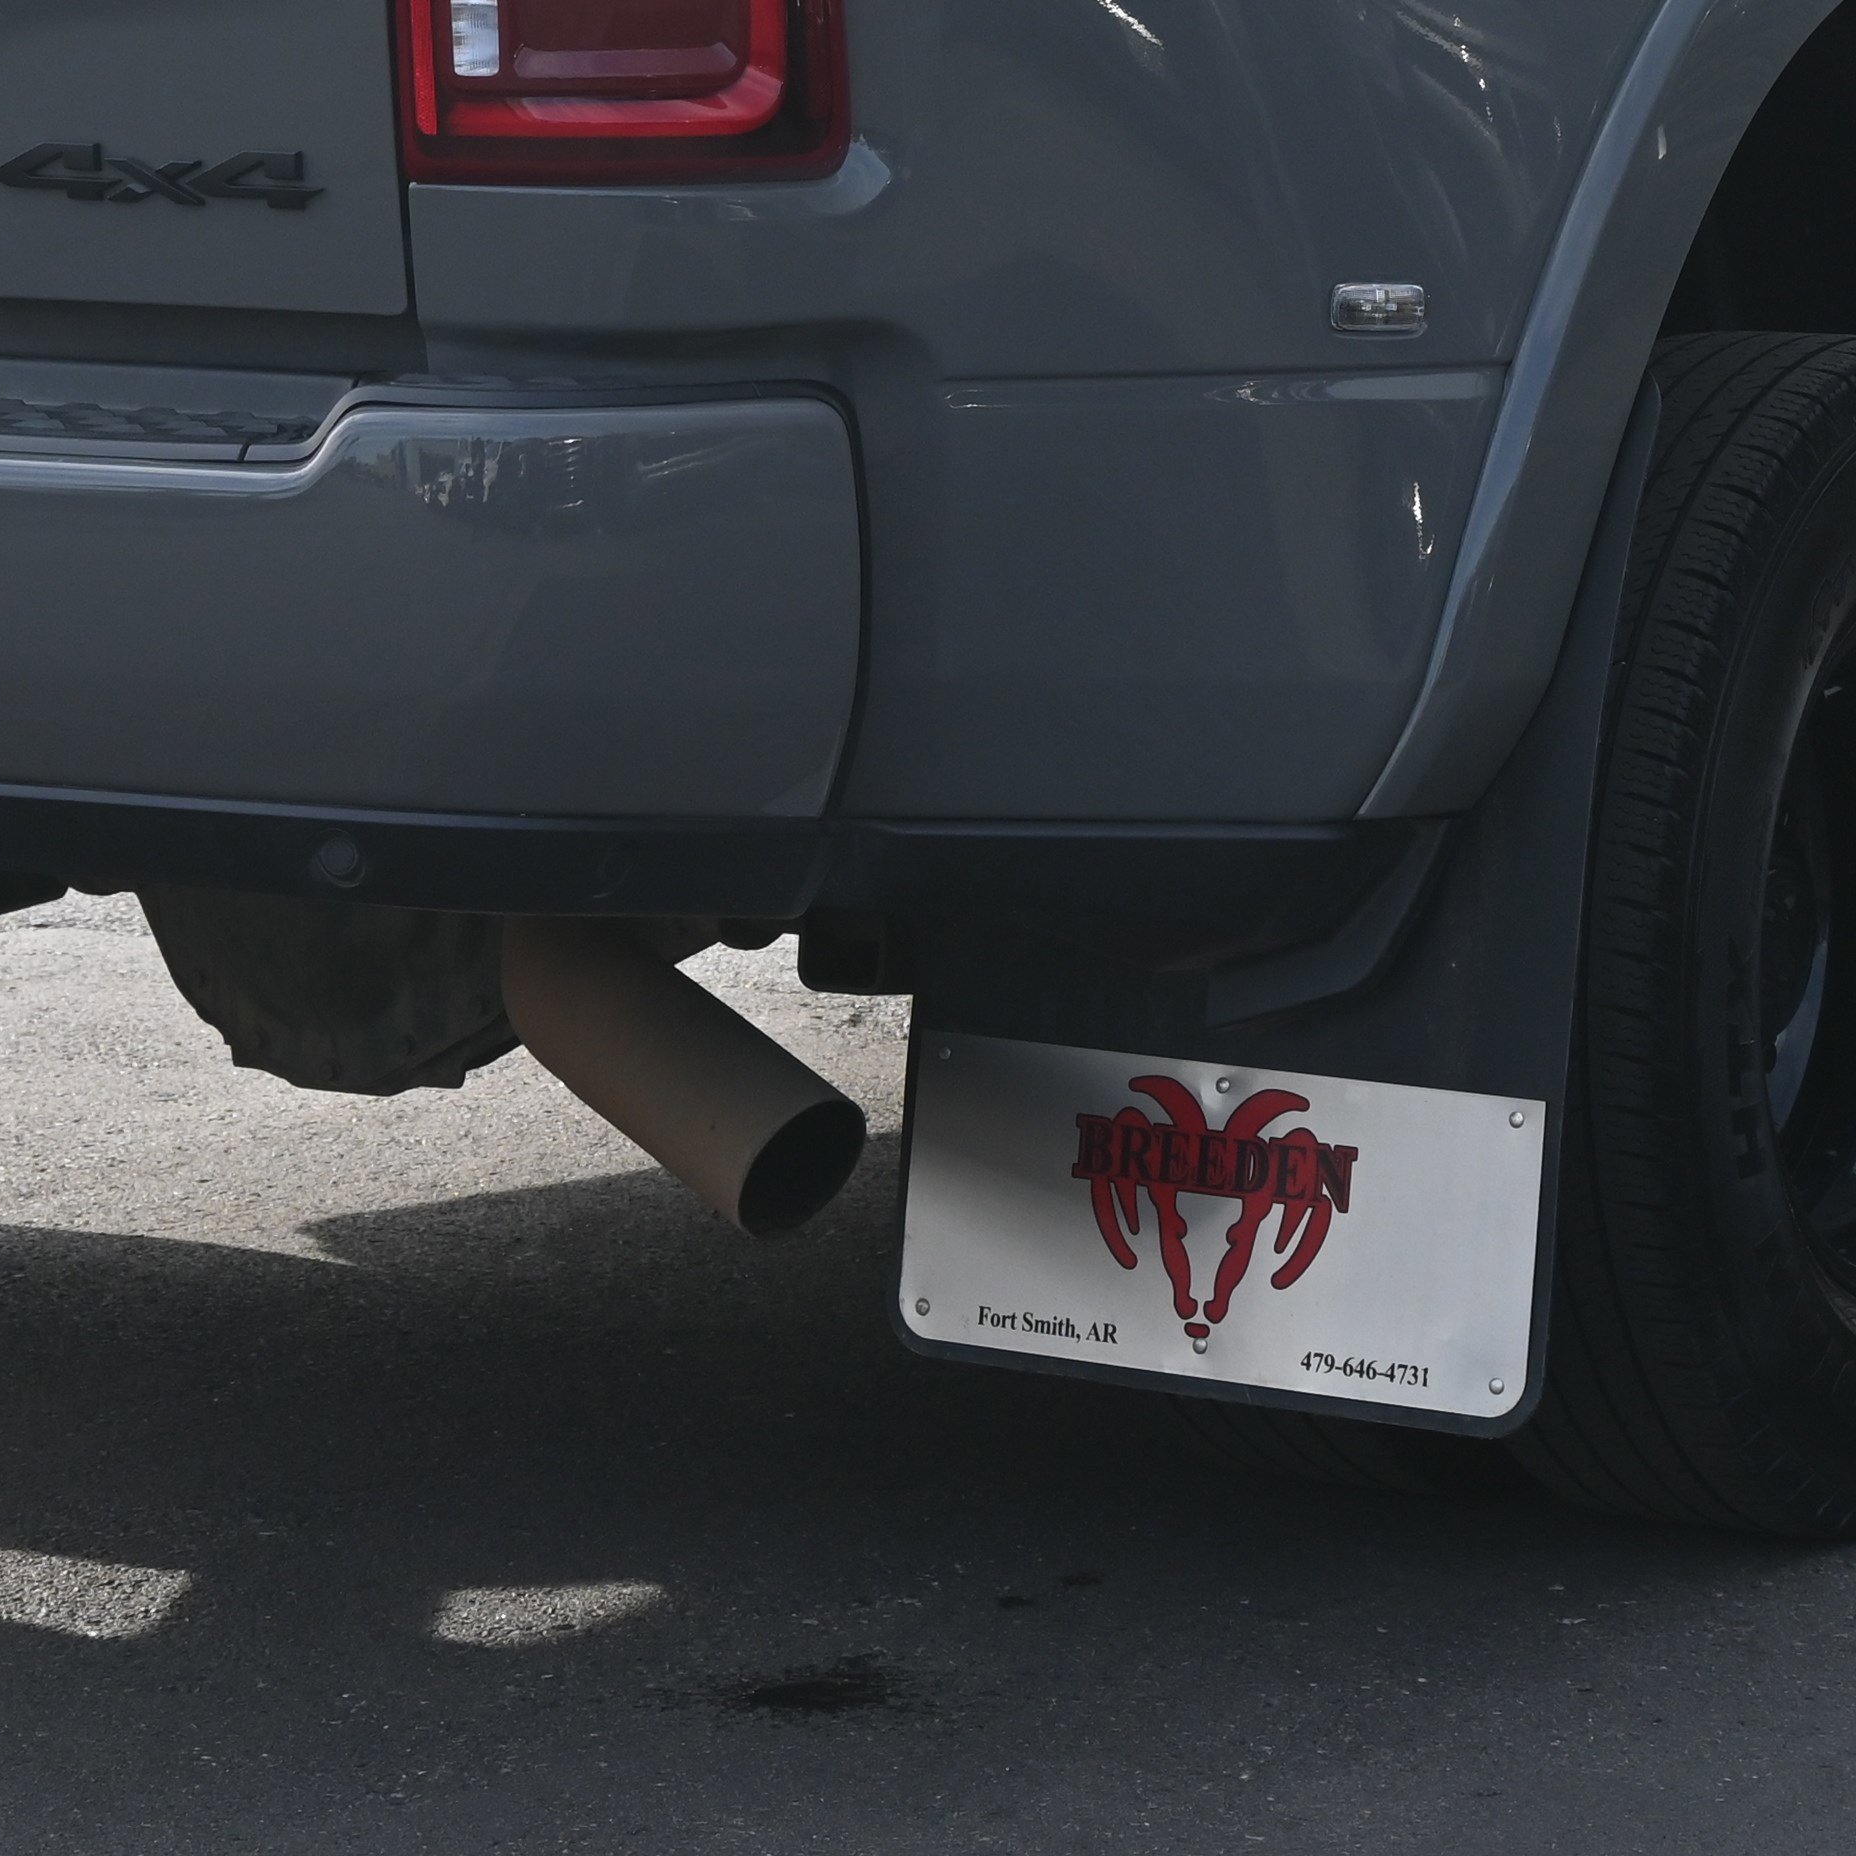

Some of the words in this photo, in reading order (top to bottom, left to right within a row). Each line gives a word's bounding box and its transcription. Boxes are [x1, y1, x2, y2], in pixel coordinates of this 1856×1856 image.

[1071, 1111, 1359, 1214] BREEDEN
[977, 1305, 1018, 1331] Fort
[1021, 1311, 1082, 1344] Smith,
[1085, 1321, 1119, 1345] AR
[1300, 1351, 1430, 1387] 479-646-4731
